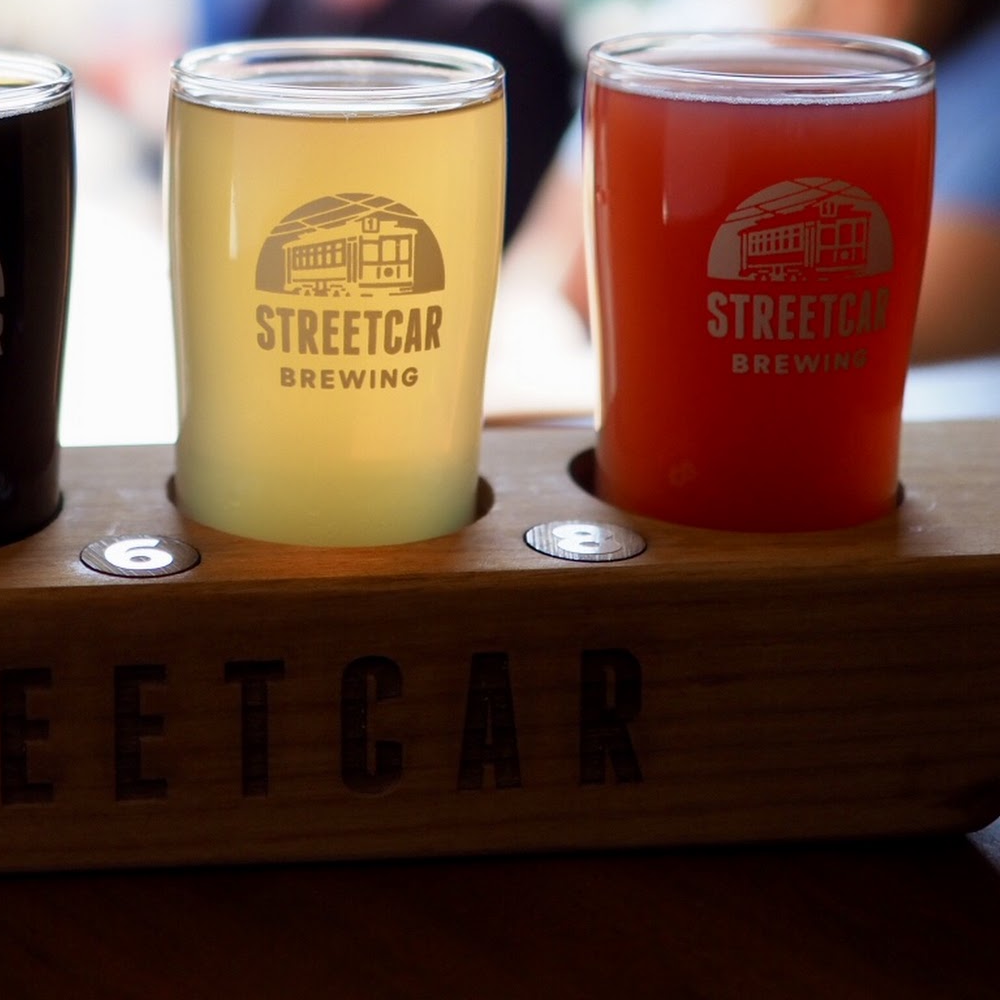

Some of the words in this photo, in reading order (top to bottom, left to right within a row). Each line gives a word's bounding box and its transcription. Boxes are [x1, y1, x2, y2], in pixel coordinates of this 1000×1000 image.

[707, 287, 891, 340] STREETCAR
[255, 304, 443, 356] STREETCAR
[731, 349, 868, 375] BREWING
[279, 367, 419, 390] BREWING
[103, 538, 174, 570] 6
[552, 525, 622, 555] 8
